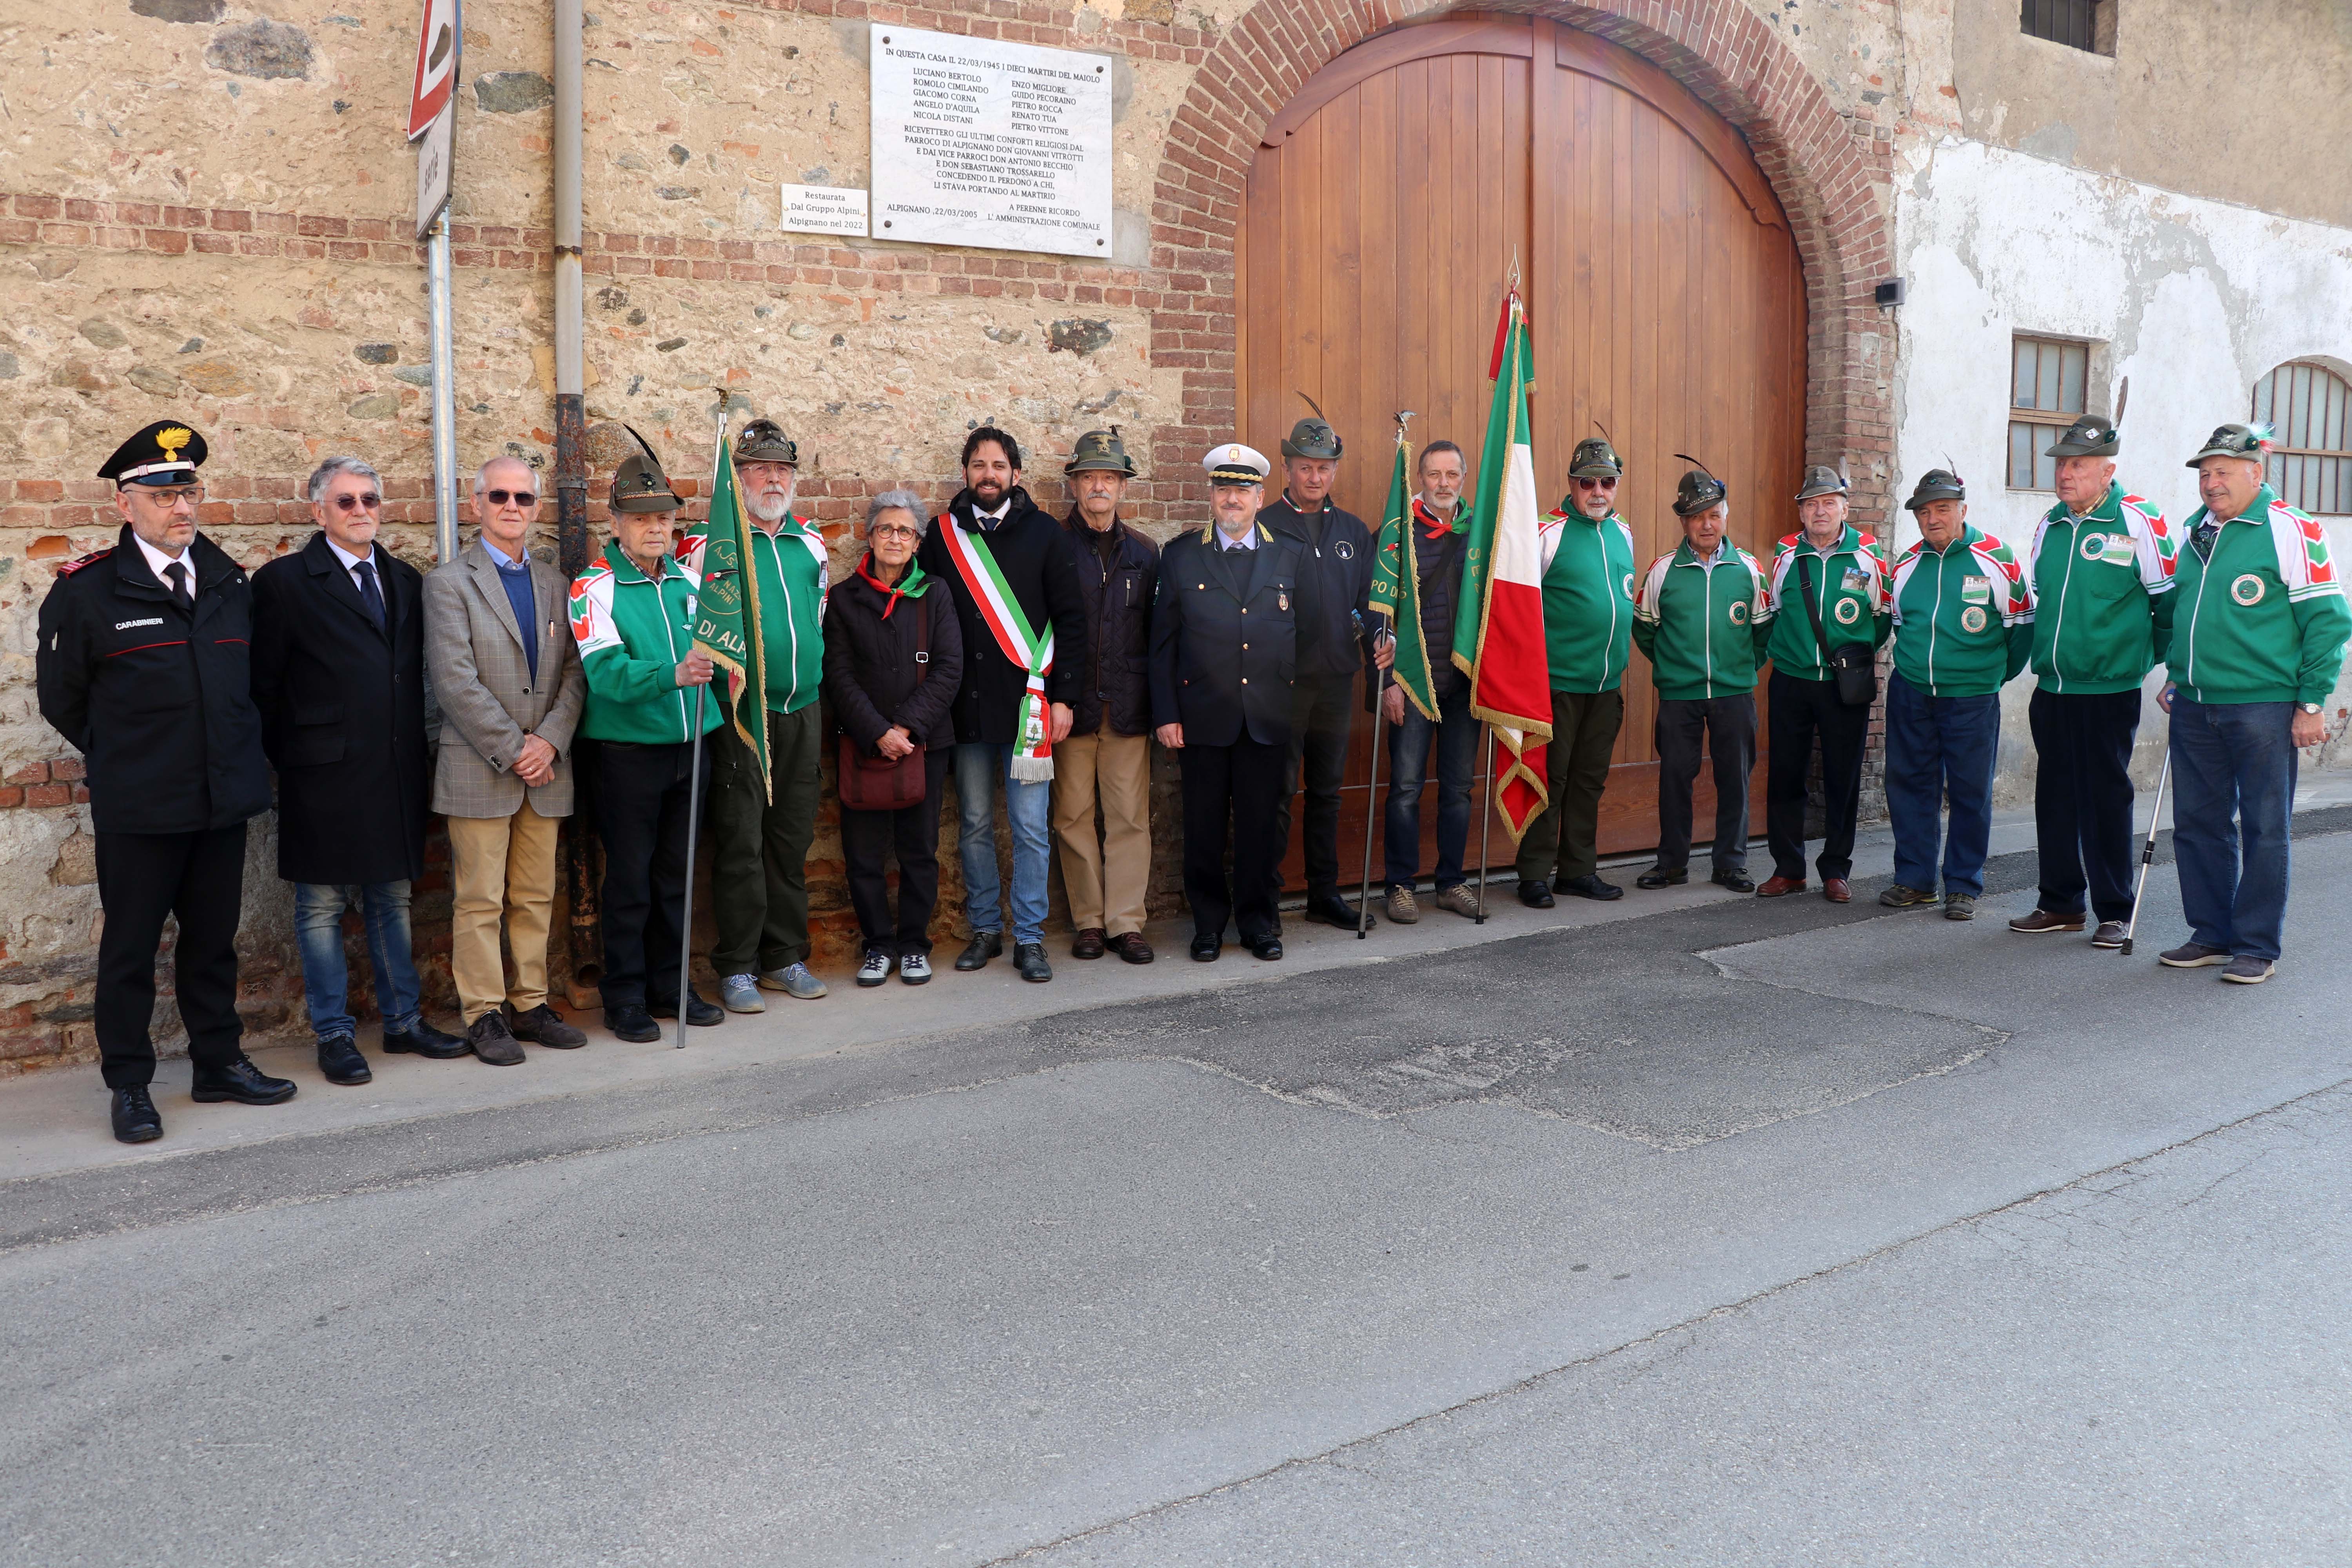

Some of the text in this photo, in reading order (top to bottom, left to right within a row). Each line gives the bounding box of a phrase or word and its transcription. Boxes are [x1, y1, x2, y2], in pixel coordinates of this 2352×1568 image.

[885, 47, 894, 56] IN
[896, 49, 926, 60] QUESTA
[927, 53, 947, 62] CASA
[957, 57, 1000, 69] 22/03/1945
[1006, 64, 1025, 73] DIECI
[1027, 67, 1056, 77] MARTIRI
[1058, 71, 1072, 79] DEL
[1073, 73, 1100, 83] MAIOLO
[913, 67, 982, 83] LUCIANO BERTOLO
[913, 78, 989, 94] ROMOLO CIMILANDO
[1011, 80, 1066, 94] ENZO MIGLIORE
[913, 88, 976, 103] GIACOMO CORNA
[1011, 90, 1076, 105] GUIDO PECORAINO
[913, 99, 980, 114] ANGELO D'AQUILA
[1011, 100, 1063, 114] PIETRO ROCCA
[913, 110, 973, 124] NICOLA DISTANI
[1011, 111, 1057, 123] RENATO TUA
[1011, 122, 1069, 136] PIETRO VITTONE
[904, 124, 1083, 152] RICEVETTERO GLI ULTIMI CONFORTI RELIGIOSI DAL
[904, 135, 940, 146] PARROCO
[952, 140, 994, 152] ALPIGNANO
[996, 145, 1012, 154] DON
[1014, 147, 1049, 158] GIOVANNI
[1051, 151, 1083, 162] VITROTTI
[922, 147, 936, 156] DAI
[937, 149, 955, 158] VICE
[956, 151, 988, 162] PARROCI
[990, 154, 1006, 163] DON
[1007, 157, 1041, 167] ANTONIO
[1043, 161, 1073, 171] BECCHIO
[425, 145, 438, 196] serie
[942, 160, 959, 169] DON
[960, 162, 1005, 174] SEBASTIANO
[1006, 167, 1055, 179] TROSSARELLO
[936, 170, 987, 182] CONCEDENDO
[997, 176, 1031, 187] PERDONO
[1040, 181, 1054, 190] CHI,
[805, 191, 845, 201] Restaurata
[942, 182, 966, 191] STAVA
[968, 184, 1008, 195] PORTANDO
[1021, 190, 1055, 200] MARTIRIO
[791, 202, 860, 216] Dal Gruppo Alpini
[887, 203, 930, 214] ALPIGNANO
[1016, 204, 1047, 214] PERENNE
[1048, 207, 1080, 217] RICORDO
[788, 216, 828, 227] Alpignano
[844, 220, 862, 229] 2022
[995, 214, 1061, 227] AMMINISTRAZIONE
[1062, 220, 1100, 230] COMUNALE
[709, 582, 735, 606] ALPINI
[116, 617, 163, 630] CARABINIERI
[698, 619, 717, 638] DI
